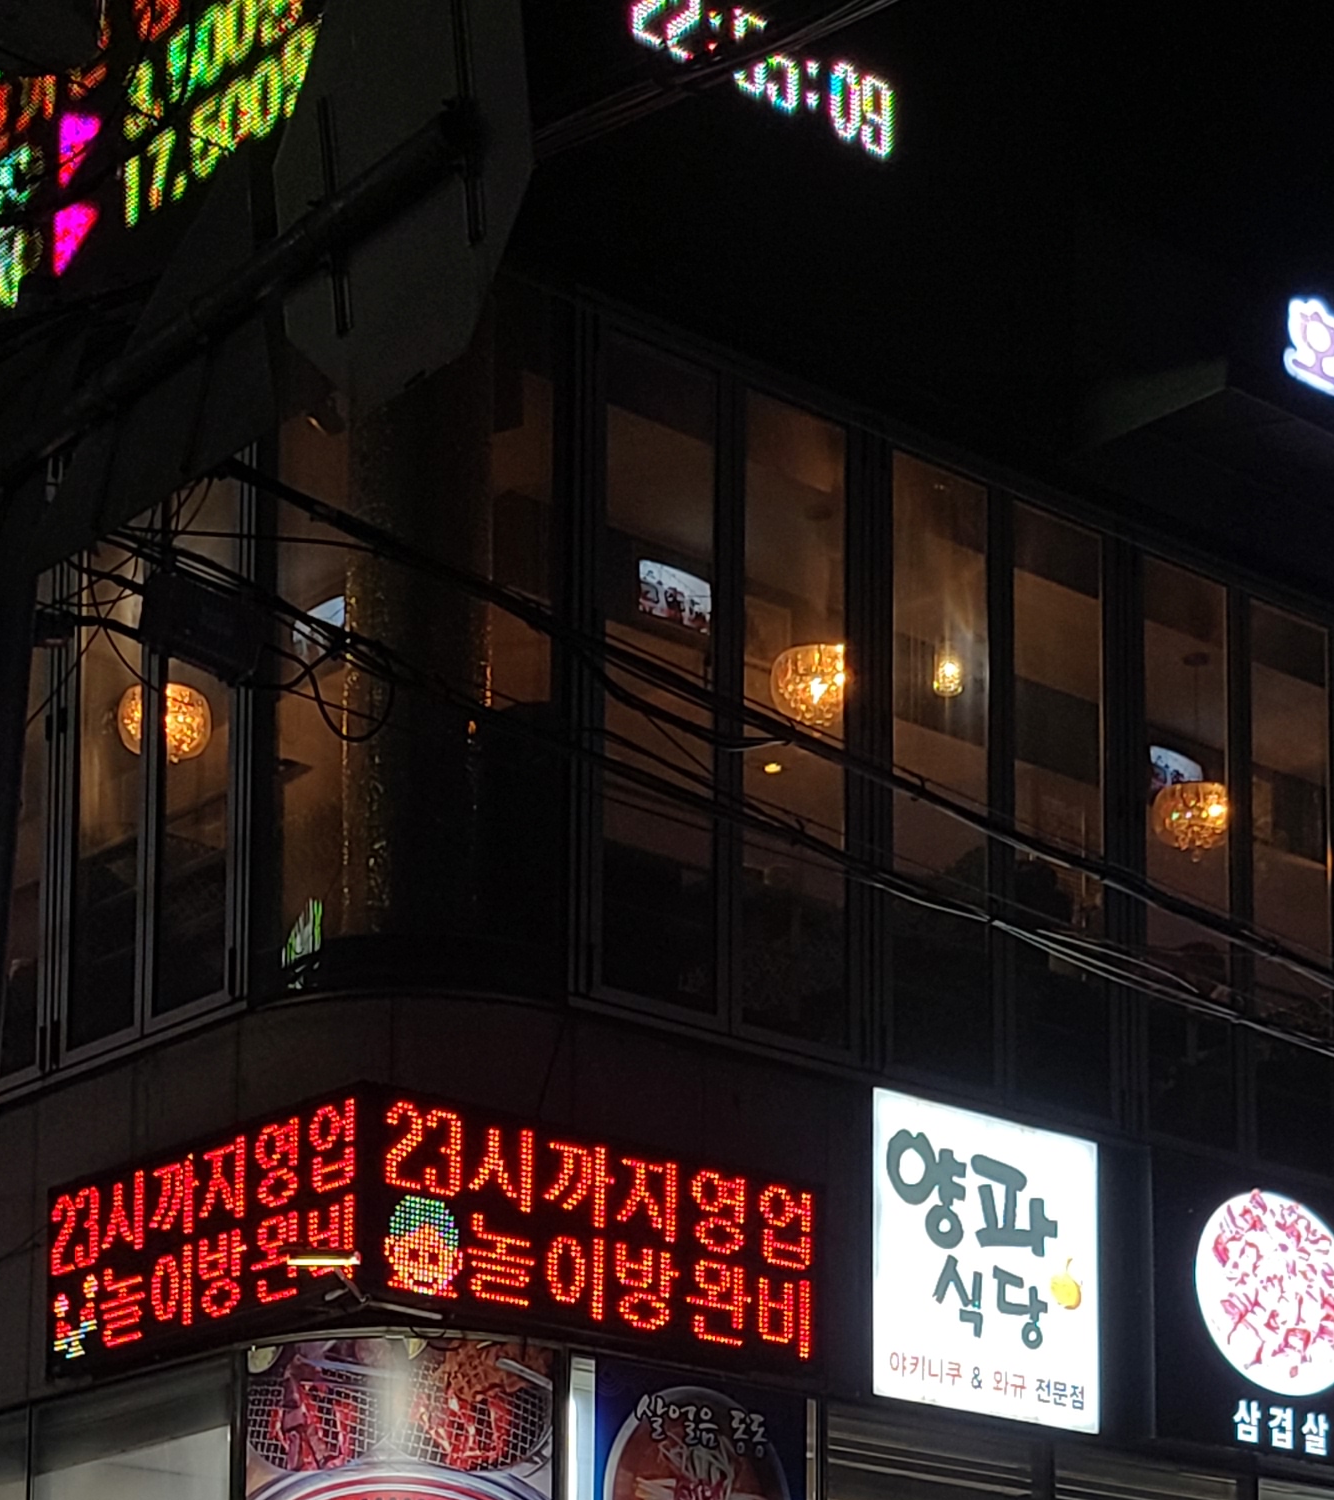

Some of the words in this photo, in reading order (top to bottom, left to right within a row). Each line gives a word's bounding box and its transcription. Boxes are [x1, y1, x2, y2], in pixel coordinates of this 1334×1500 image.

[932, 1254, 1048, 1350] 식당
[889, 1352, 963, 1386] 야키니쿠
[971, 1366, 982, 1389] &
[993, 1371, 1027, 1399] 와규
[1035, 1379, 1085, 1411] 전문점
[635, 1394, 719, 1447] 살얼음
